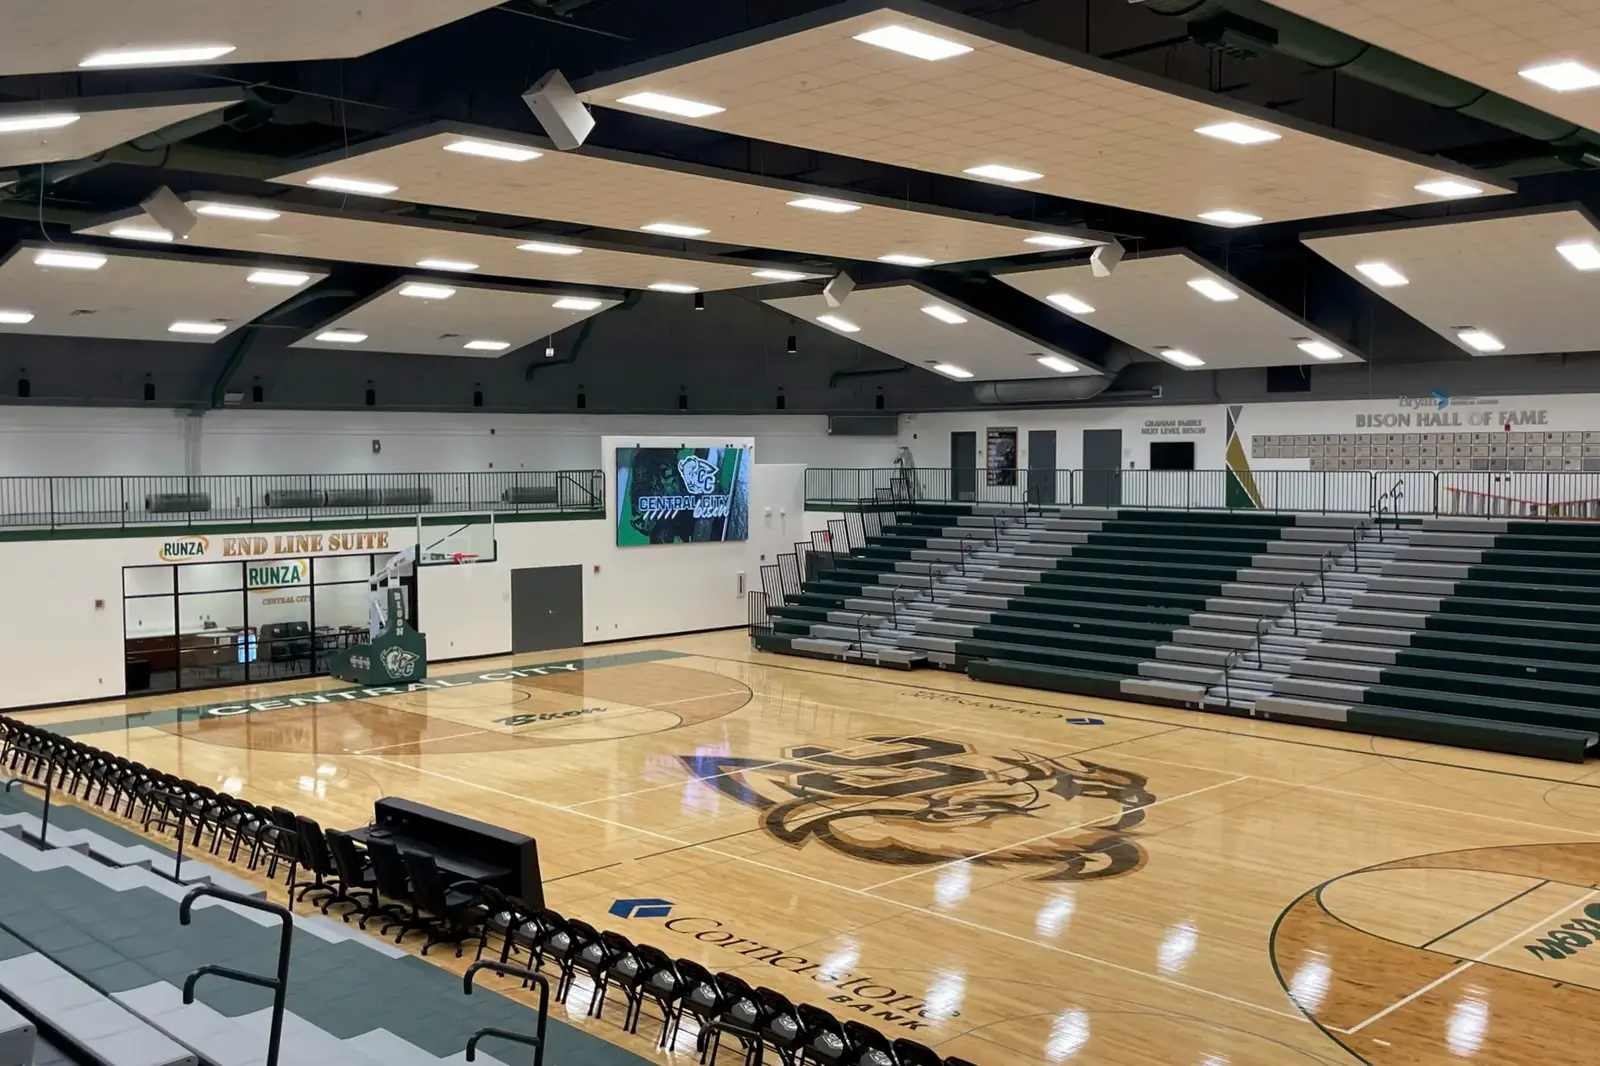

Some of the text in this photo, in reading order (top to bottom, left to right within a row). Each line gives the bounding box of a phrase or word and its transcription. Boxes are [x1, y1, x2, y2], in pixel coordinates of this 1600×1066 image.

[1355, 410, 1549, 428] BISON HALL OF FAME
[639, 495, 732, 511] CENTRAL CITY
[163, 541, 204, 556] RUNZA
[223, 531, 390, 557] END LINE SUITE
[249, 565, 301, 586] RUNZA
[394, 592, 404, 636] BISON
[206, 662, 580, 717] CENTRAL CITY
[828, 994, 930, 1032] BANK
